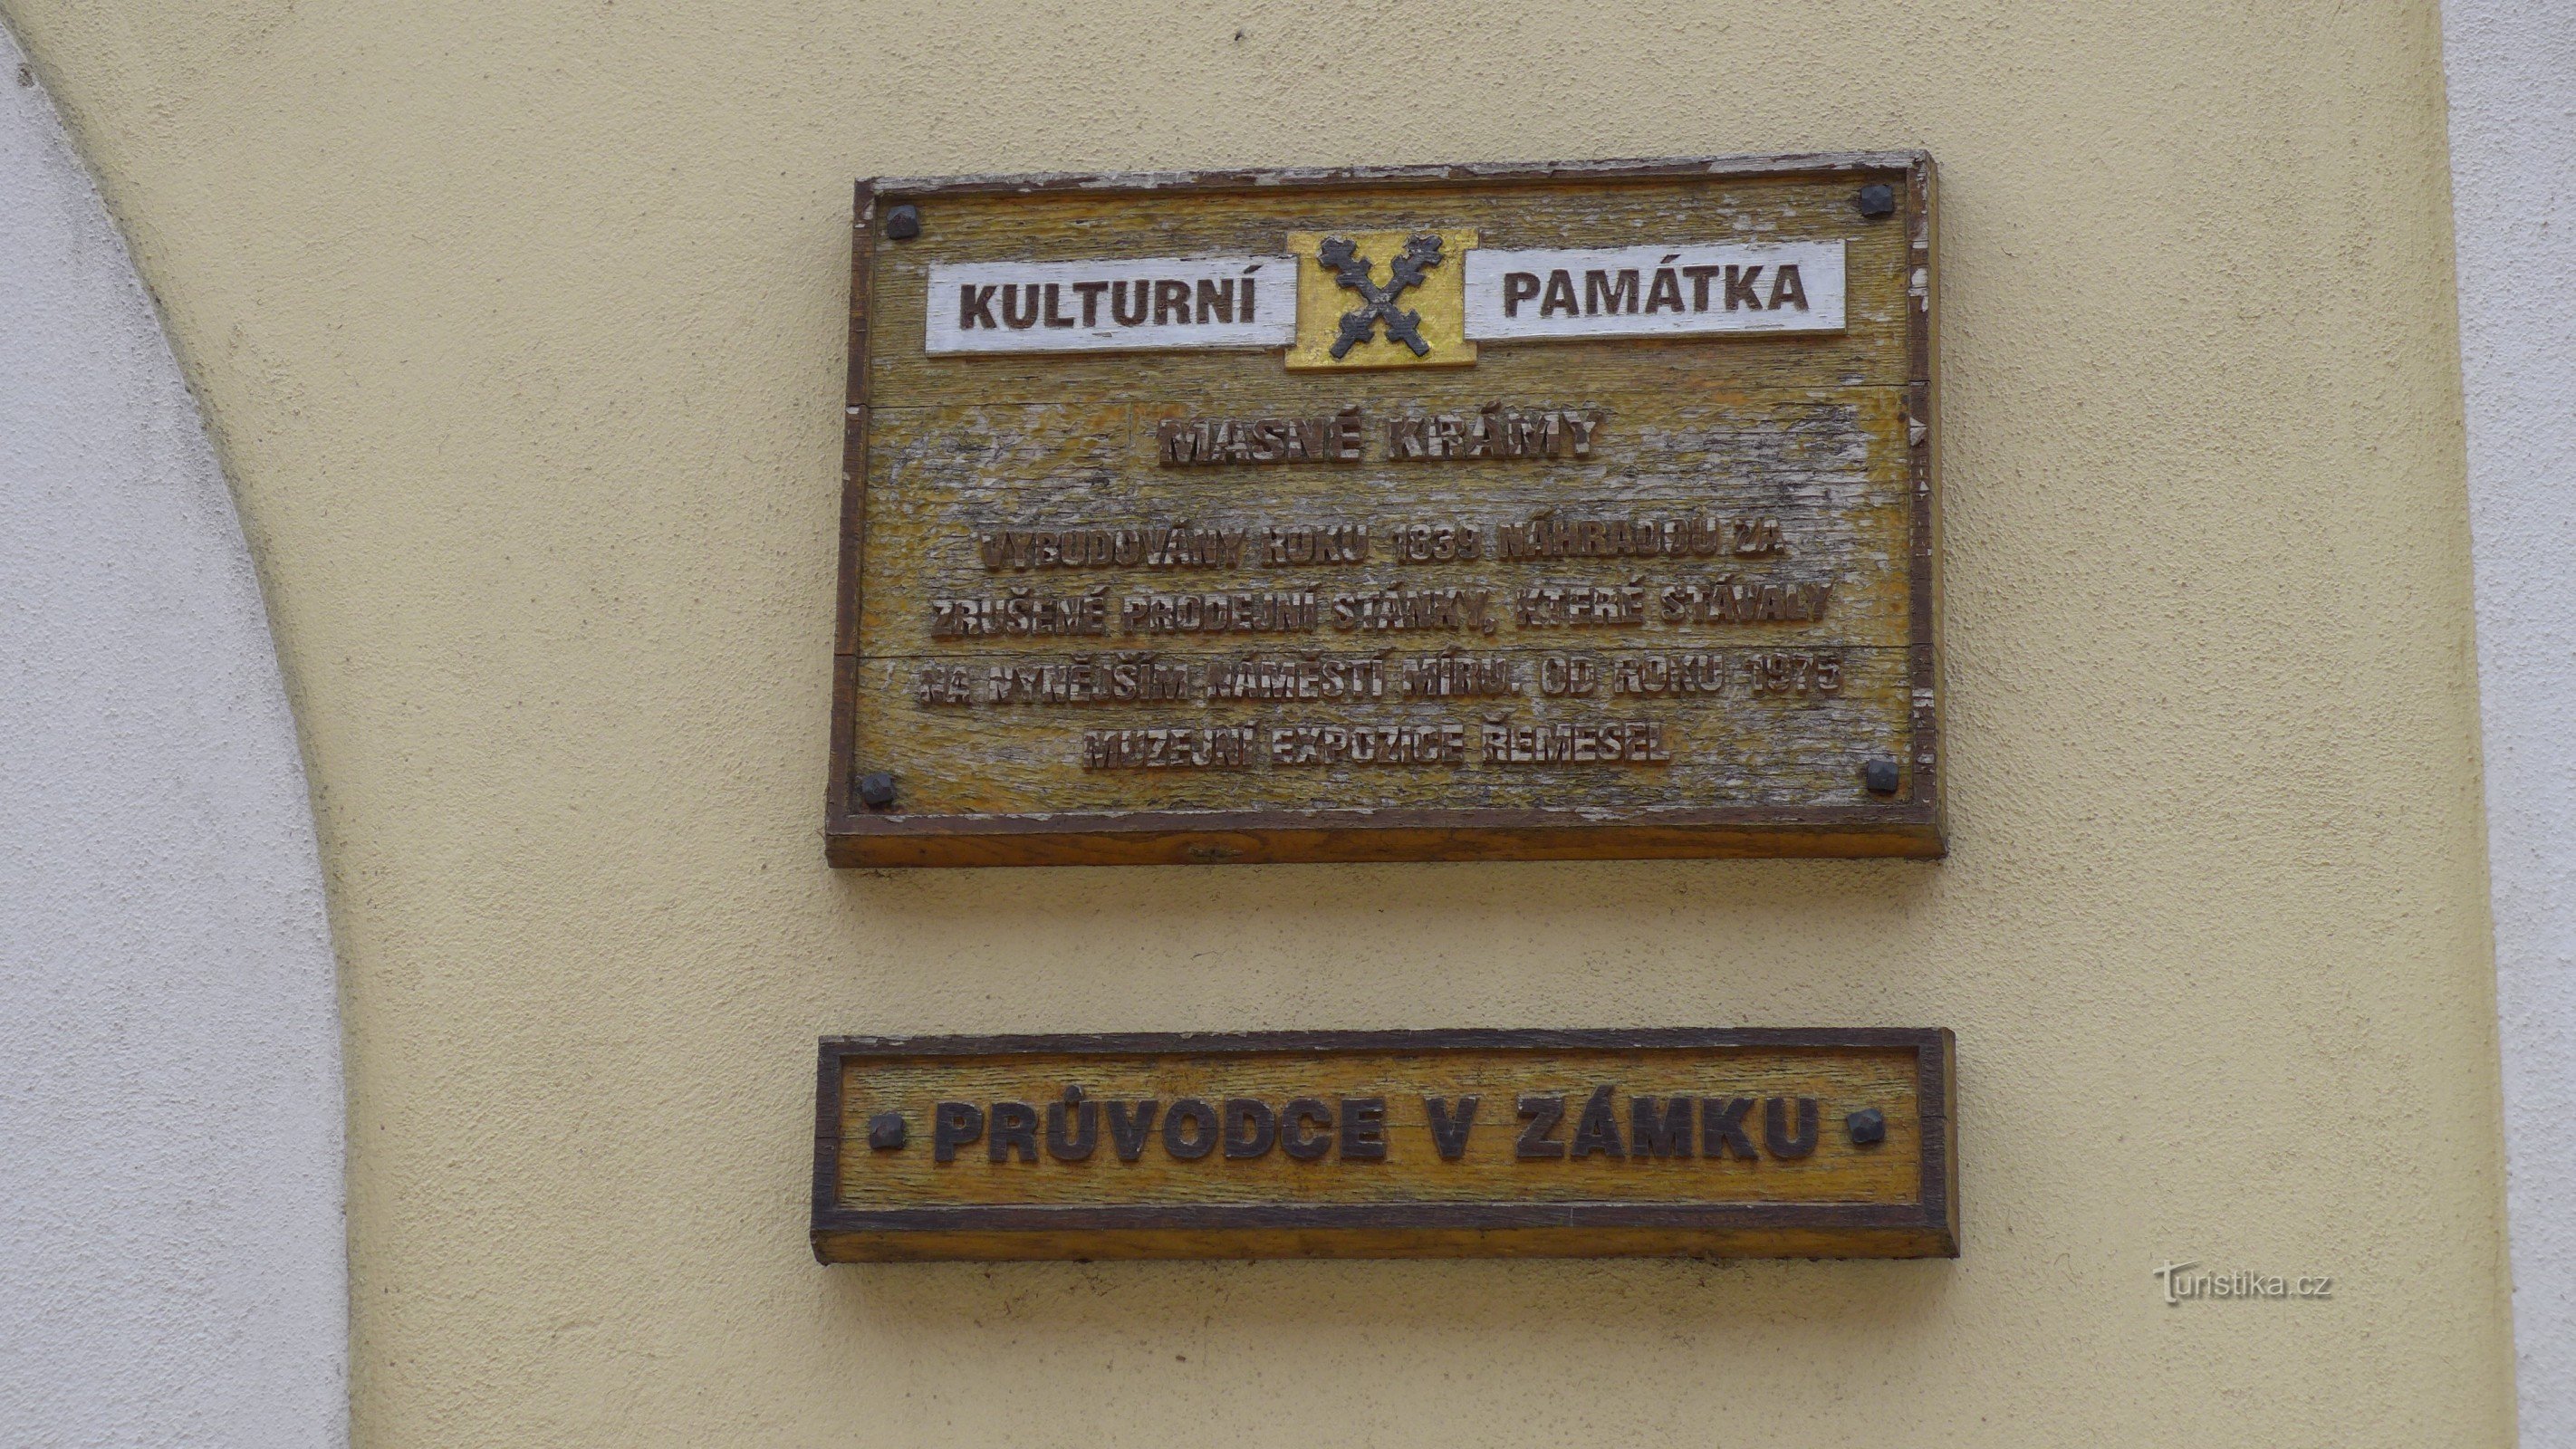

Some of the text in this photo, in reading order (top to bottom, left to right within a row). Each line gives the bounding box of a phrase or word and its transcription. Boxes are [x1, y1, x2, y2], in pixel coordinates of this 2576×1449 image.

[960, 254, 1809, 330] KULTURNÍ PAMÁTKA
[1158, 400, 1600, 466] MASNÉ KRÁMY
[980, 508, 1787, 571] VYBUDOVÁNY ROKU 1839 NÁHRADOU ZA
[931, 573, 1835, 636] ZRUŠENÉ PRODEJNÍ STÁNKY, KTERÉ STÁVALY
[919, 664, 970, 704] NA
[1206, 648, 1387, 699] NÁMĚSTÍ
[1541, 656, 1600, 696] OD
[1613, 653, 1723, 694] ROKU
[1744, 651, 1844, 693] 1975
[1083, 711, 1670, 769] MUZEJNÍ EXPOZICE ŘEMESEL
[934, 1086, 1818, 1162] PRŮVODCE V ZÁMKU
